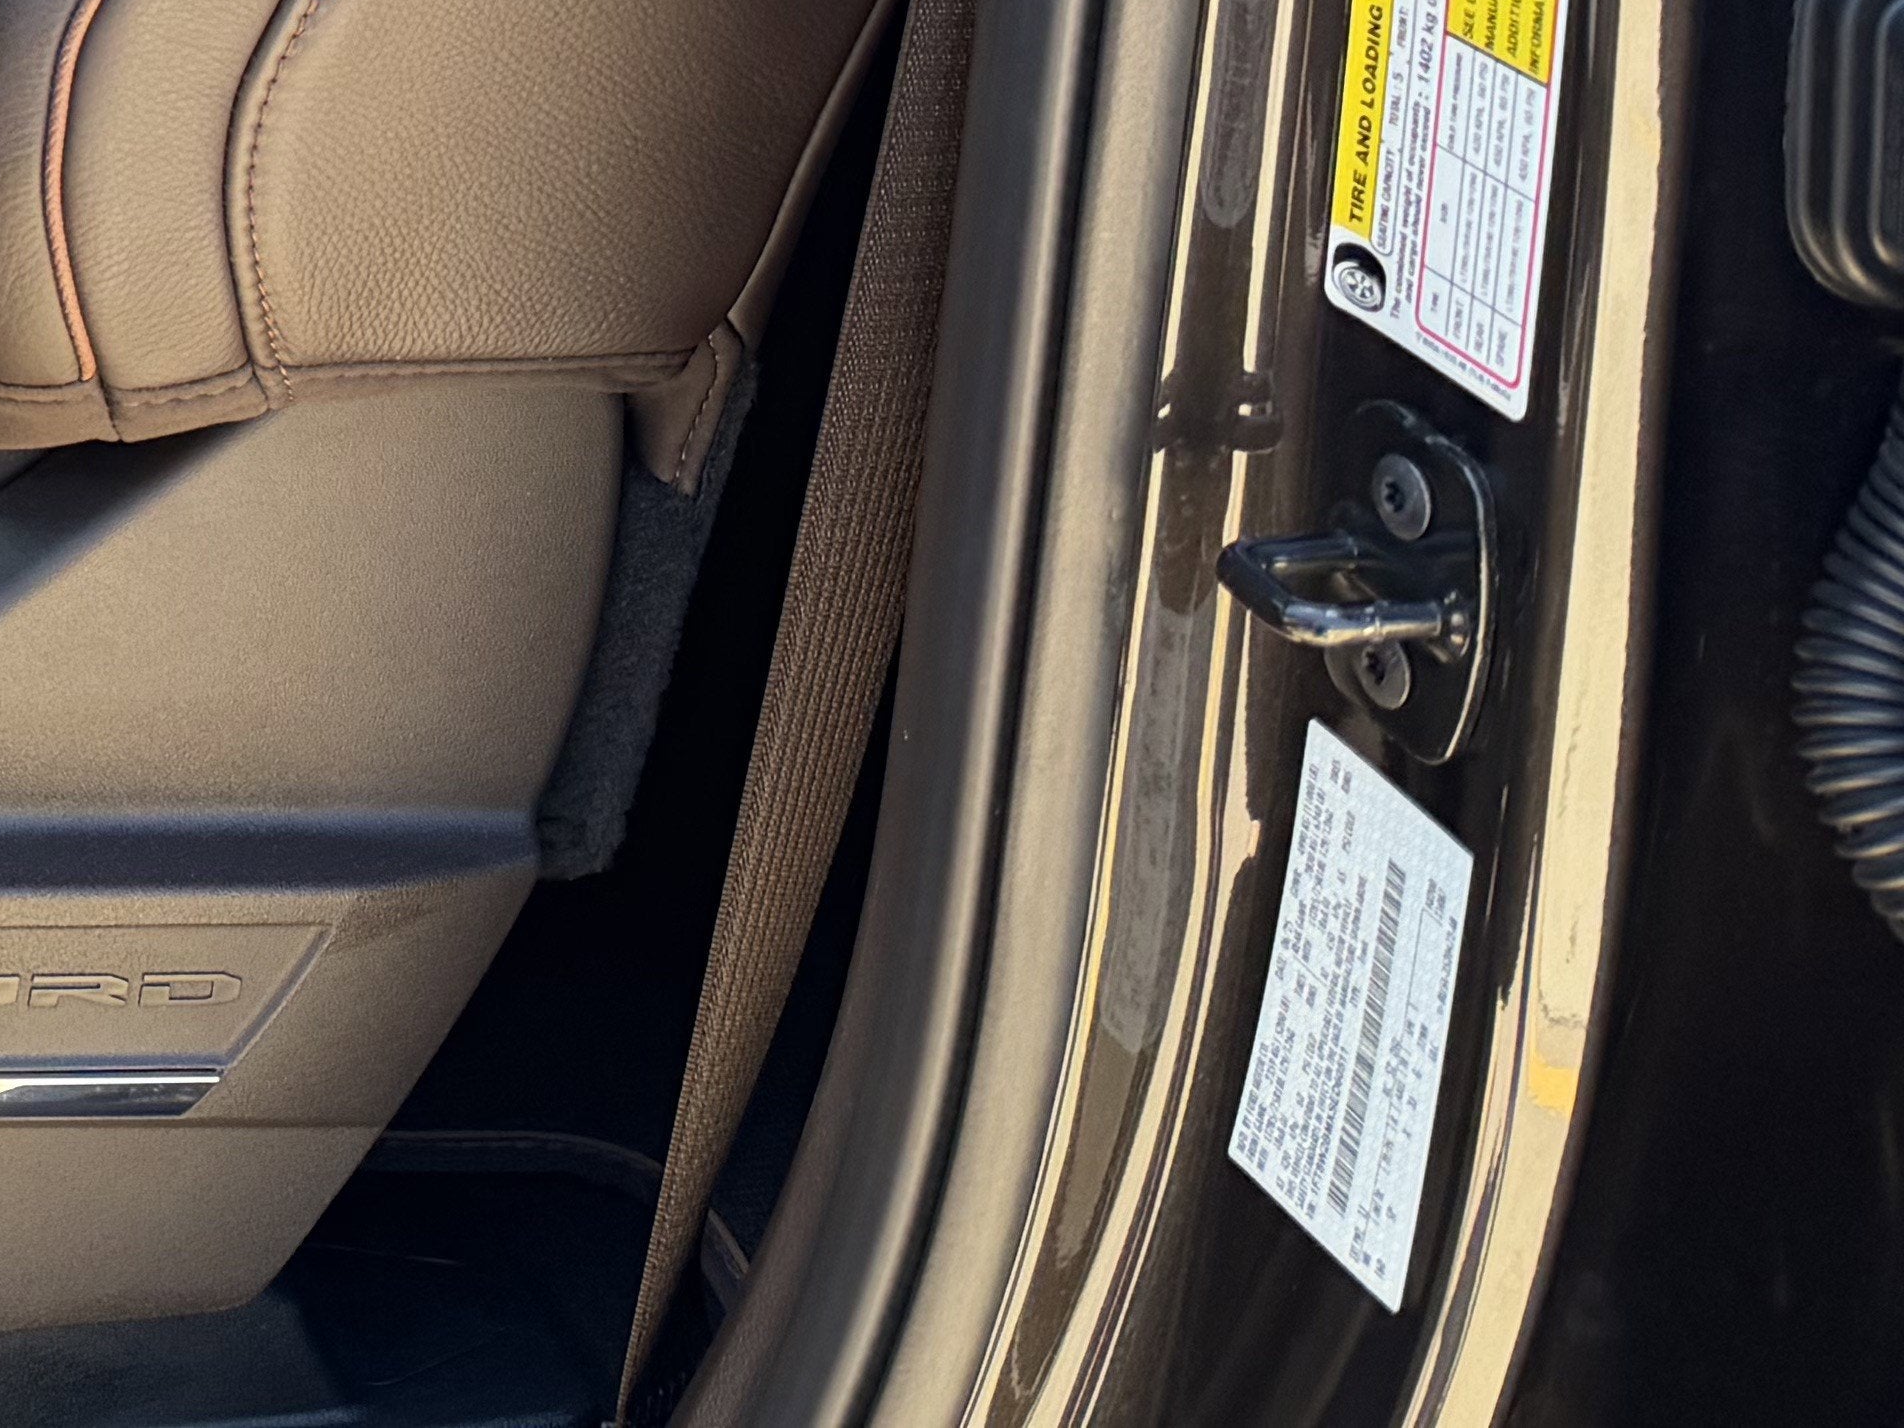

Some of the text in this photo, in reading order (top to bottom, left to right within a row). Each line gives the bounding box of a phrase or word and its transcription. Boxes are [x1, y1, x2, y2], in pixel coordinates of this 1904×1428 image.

[1422, 11, 1438, 35] kg
[1462, 9, 1475, 40] SEE
[1360, 4, 1383, 109] LOADING
[1417, 37, 1434, 83] 1402
[1355, 115, 1372, 166] AND
[1349, 169, 1367, 222] TIRE
[1390, 100, 1421, 319] The combined weight of occupants
